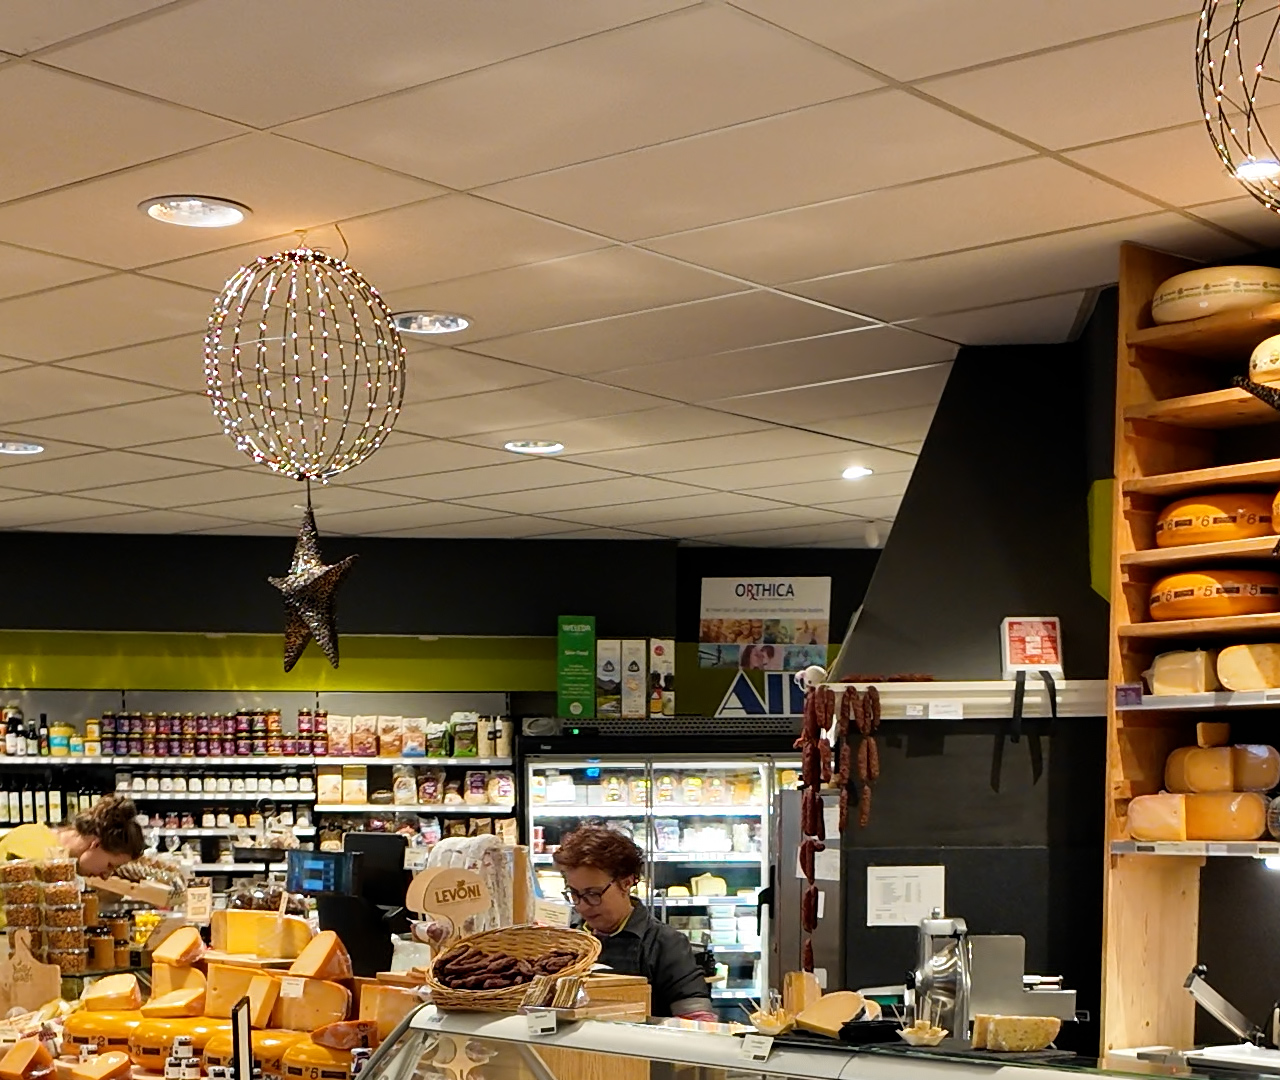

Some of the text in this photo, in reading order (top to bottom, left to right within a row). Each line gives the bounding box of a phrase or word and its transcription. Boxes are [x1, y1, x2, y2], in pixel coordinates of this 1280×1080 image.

[1201, 515, 1210, 527] 6
[735, 583, 795, 600] ORTHICA
[562, 624, 592, 632] WELEDA
